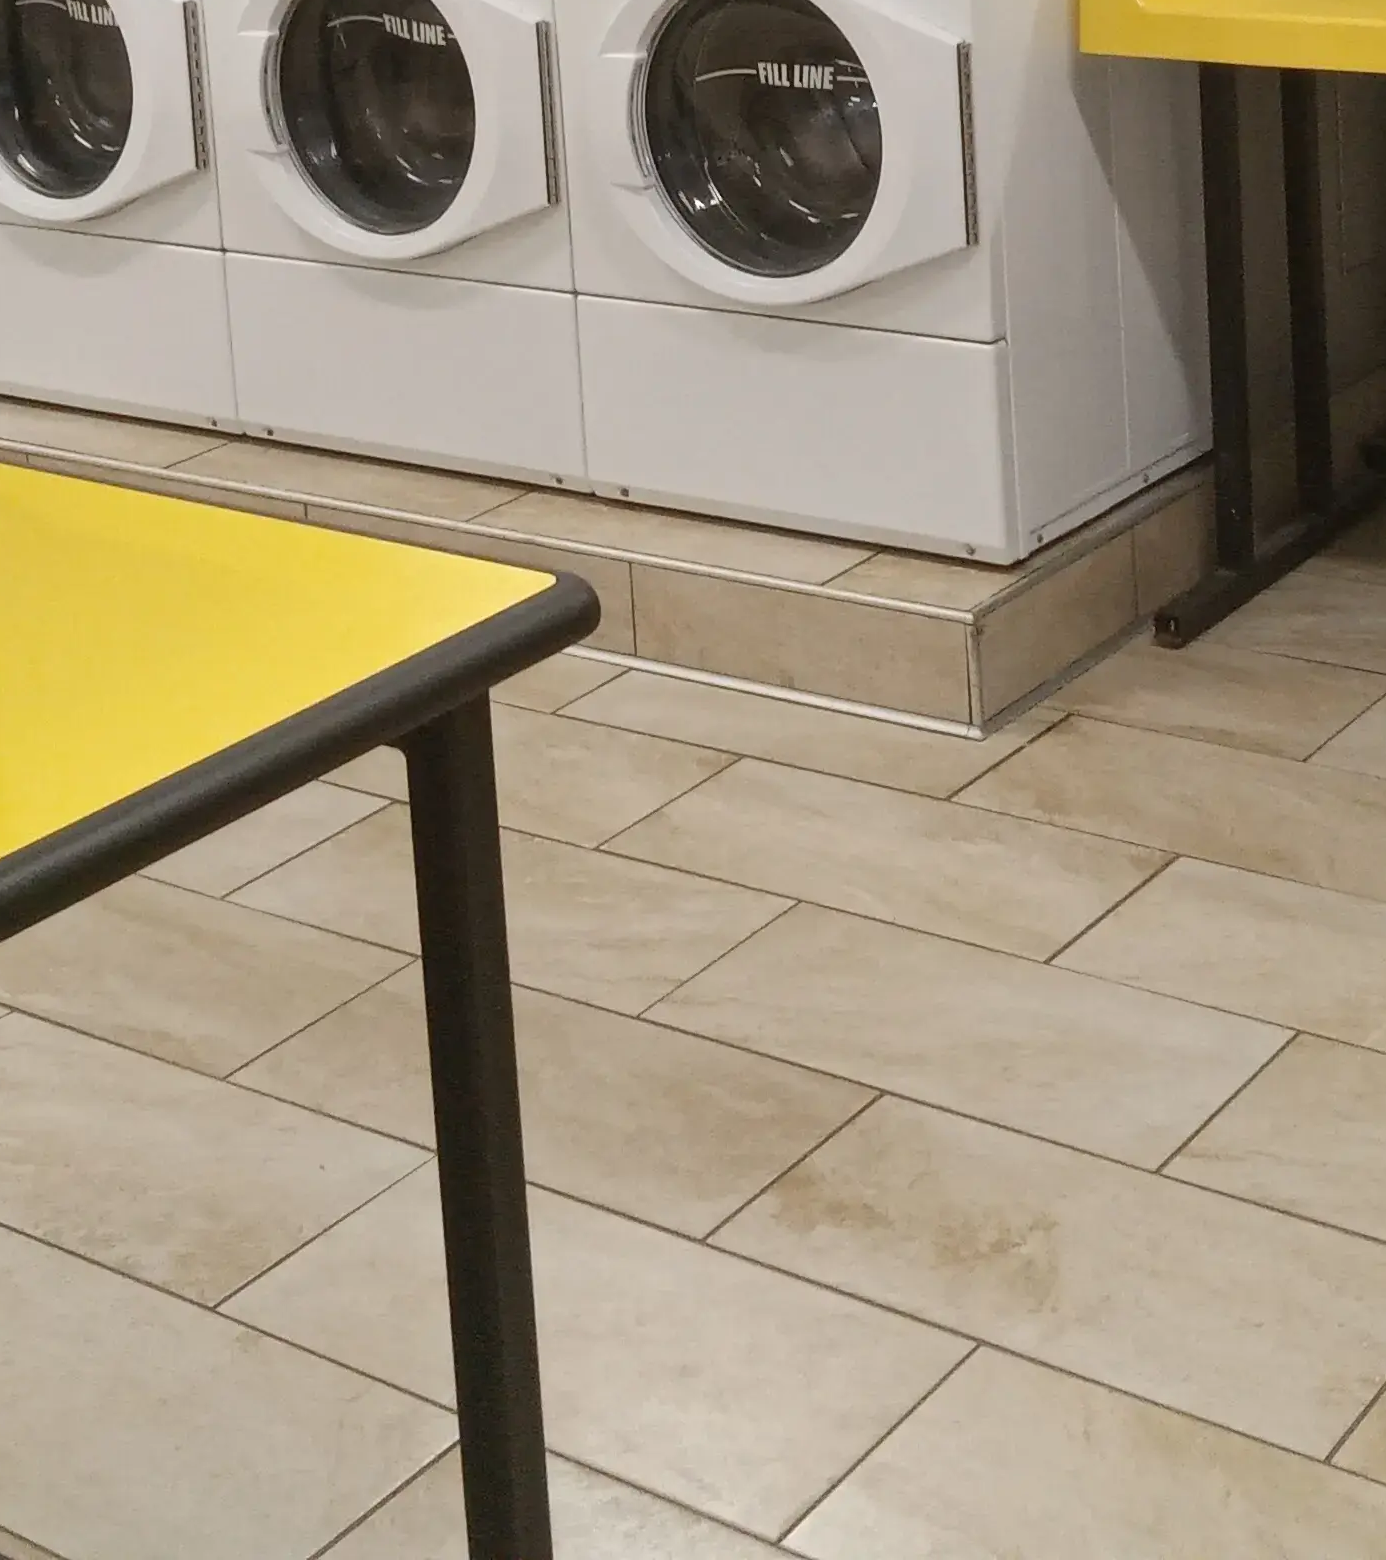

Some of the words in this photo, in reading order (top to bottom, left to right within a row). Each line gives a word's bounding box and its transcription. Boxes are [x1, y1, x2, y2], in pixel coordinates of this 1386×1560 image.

[66, 0, 90, 23] FILL
[91, 3, 119, 27] LIN
[383, 13, 411, 40] FILL
[412, 19, 446, 46] LINE
[757, 61, 790, 88] FILL
[793, 64, 834, 90] LINE
